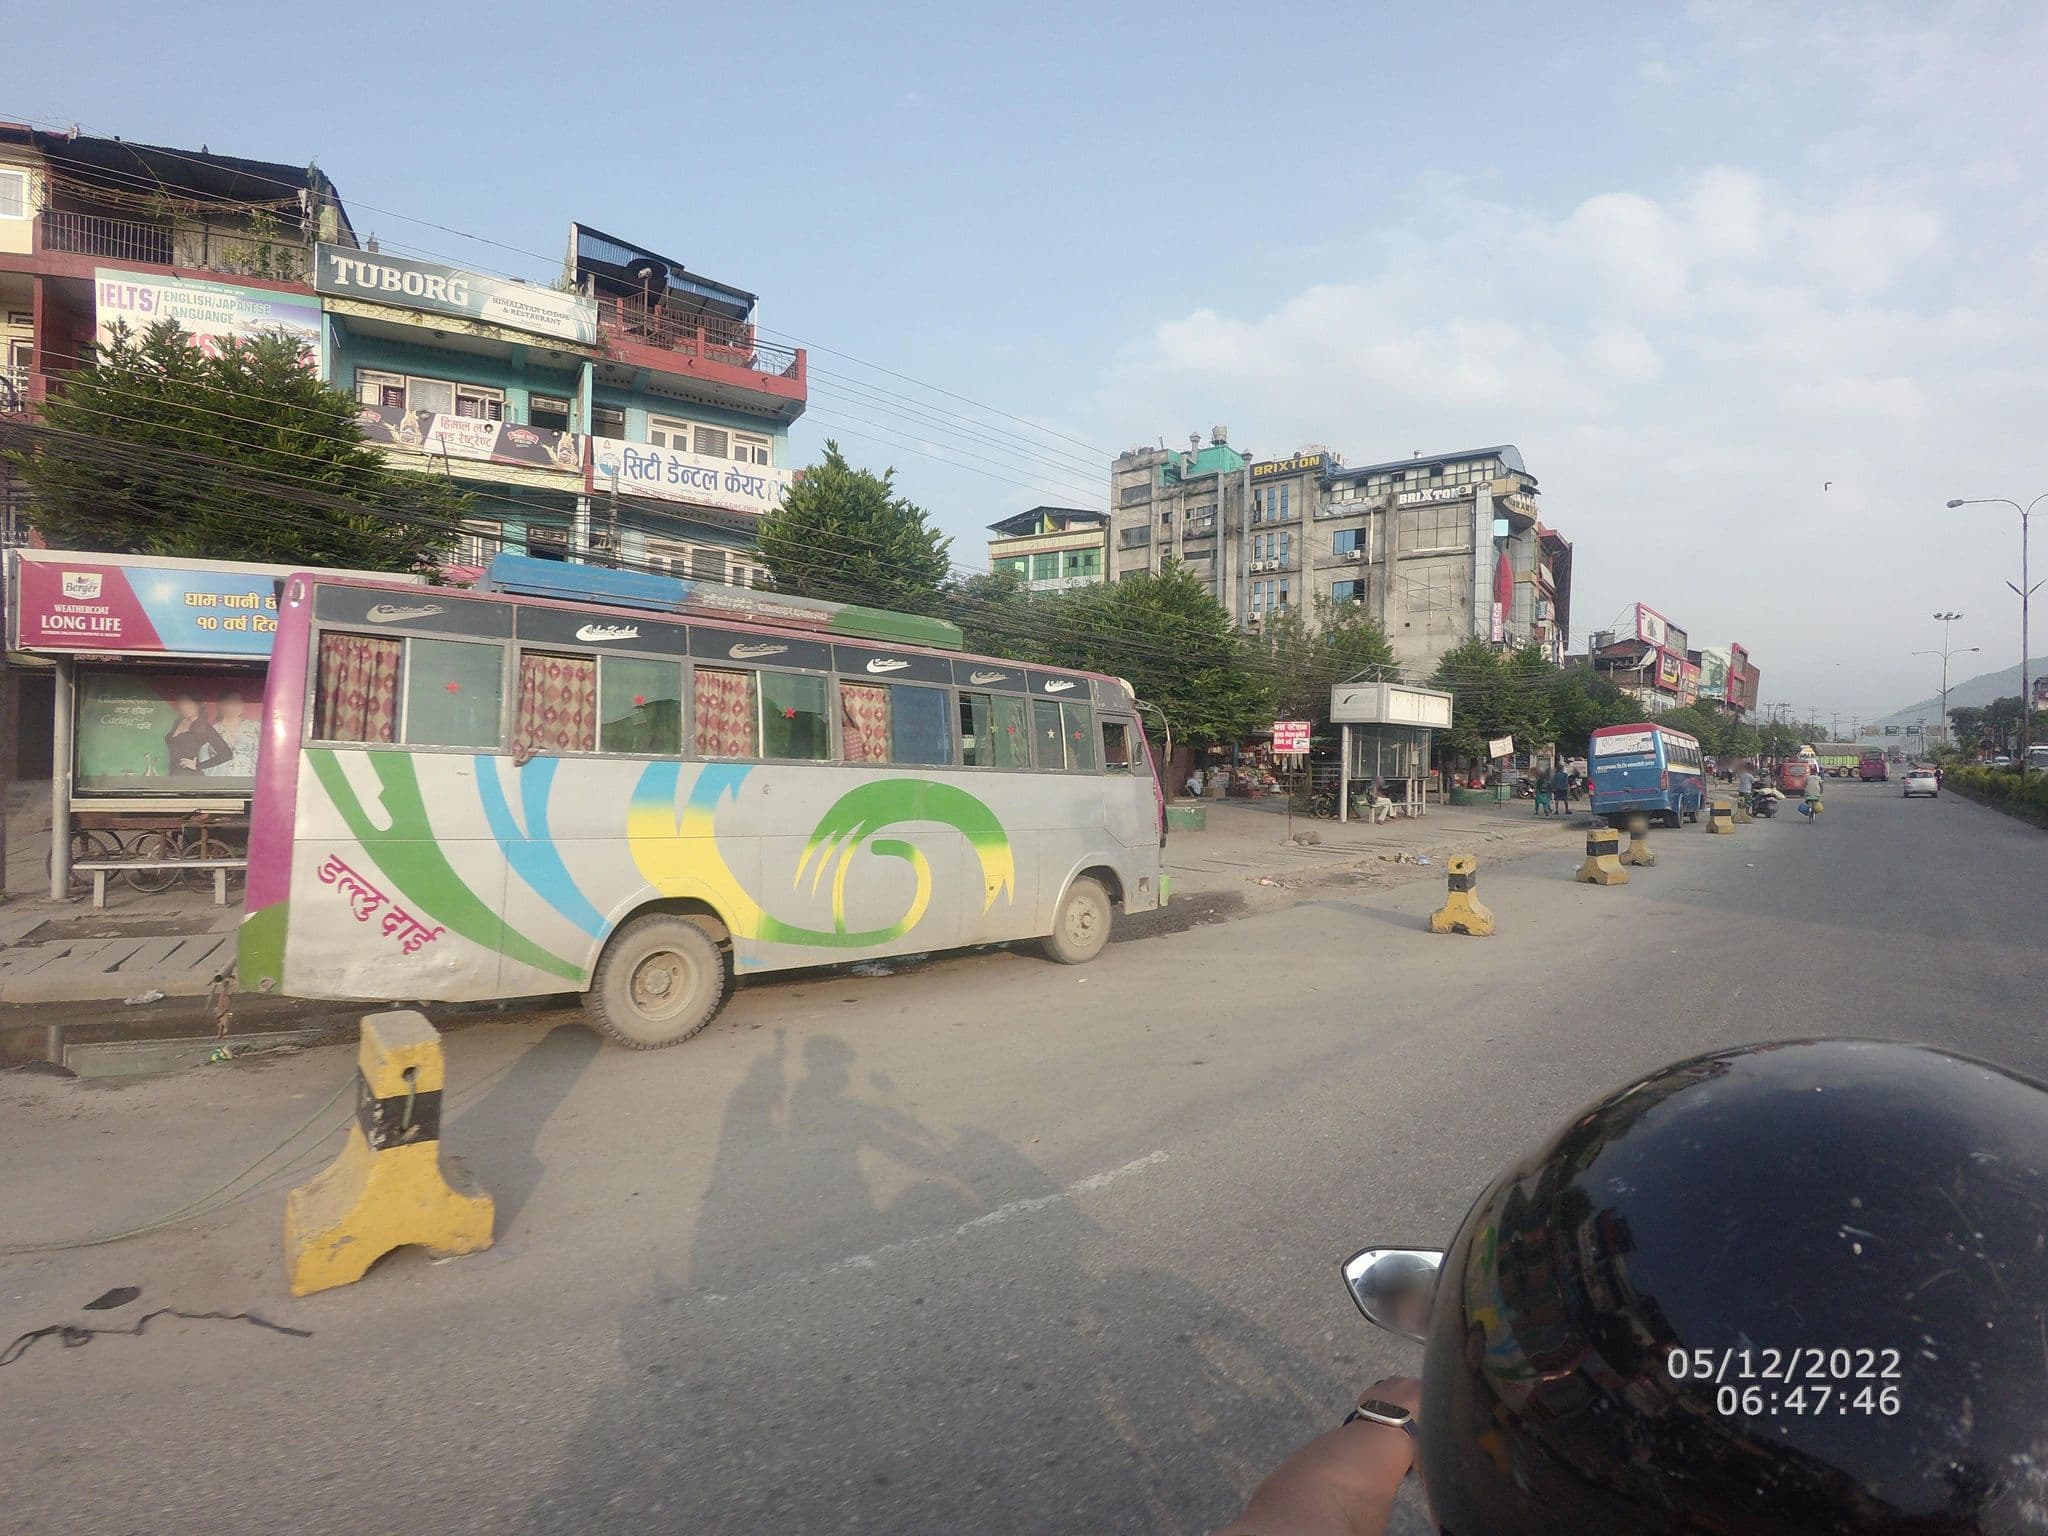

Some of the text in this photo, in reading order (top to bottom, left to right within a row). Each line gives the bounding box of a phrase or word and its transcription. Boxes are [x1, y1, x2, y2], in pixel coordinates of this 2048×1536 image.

[330, 254, 470, 307] TUBORG
[163, 304, 234, 325] LANGUANGE
[510, 308, 562, 326] RESTAURANT
[623, 447, 662, 482] सिटी
[667, 455, 719, 491] डेन्टल
[725, 466, 766, 500] केयर
[1253, 455, 1320, 477] BRIXTON
[65, 582, 99, 595] Berger
[54, 604, 110, 615] WEATHERCOAT
[41, 614, 122, 632] LONG LIFE
[196, 616, 218, 631] १०
[222, 614, 249, 632] वर्ष
[317, 853, 446, 955] डल्लु दाई
